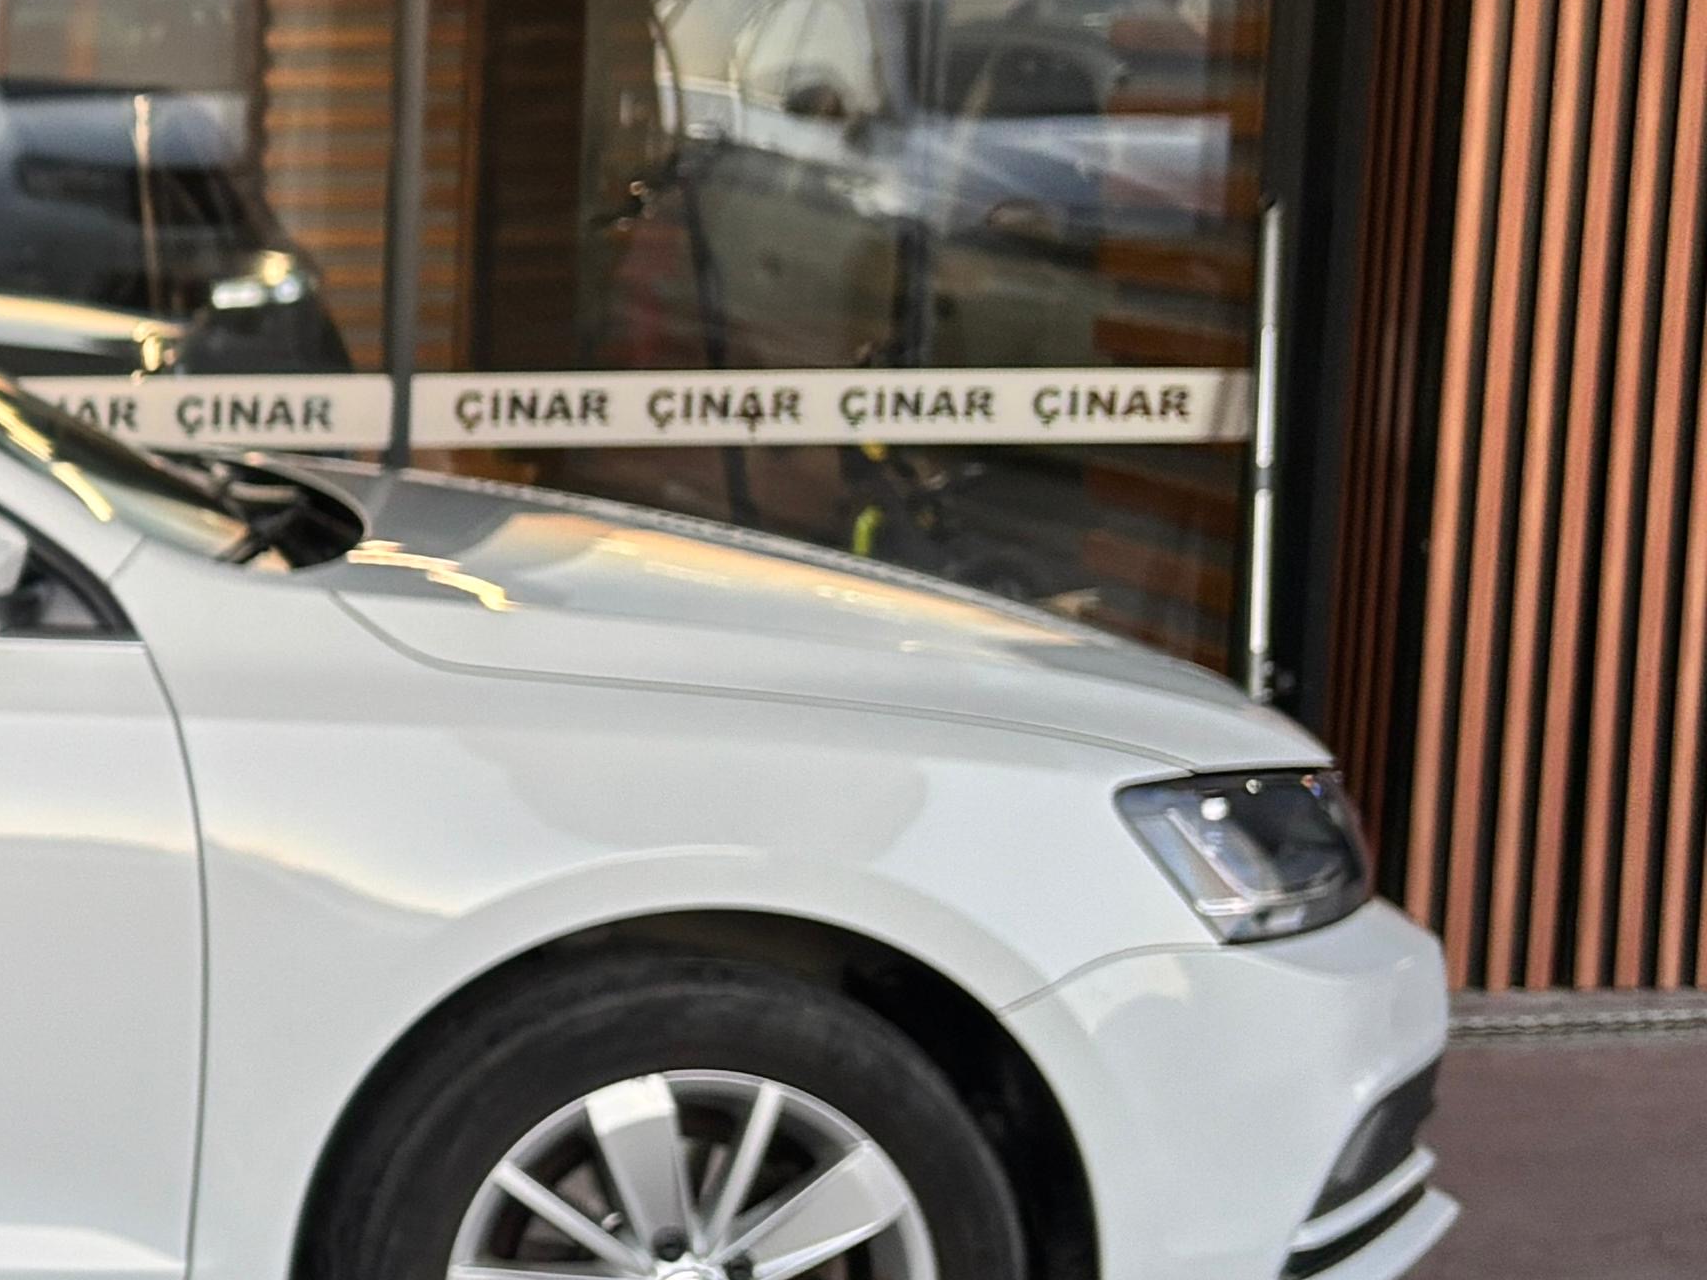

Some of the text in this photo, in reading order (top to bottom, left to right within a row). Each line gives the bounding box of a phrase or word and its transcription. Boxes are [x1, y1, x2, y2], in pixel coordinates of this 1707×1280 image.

[176, 392, 333, 438] ÇINAR
[454, 384, 1191, 434] ÇINAR ÇINAR ÇINAR ÇINAR
